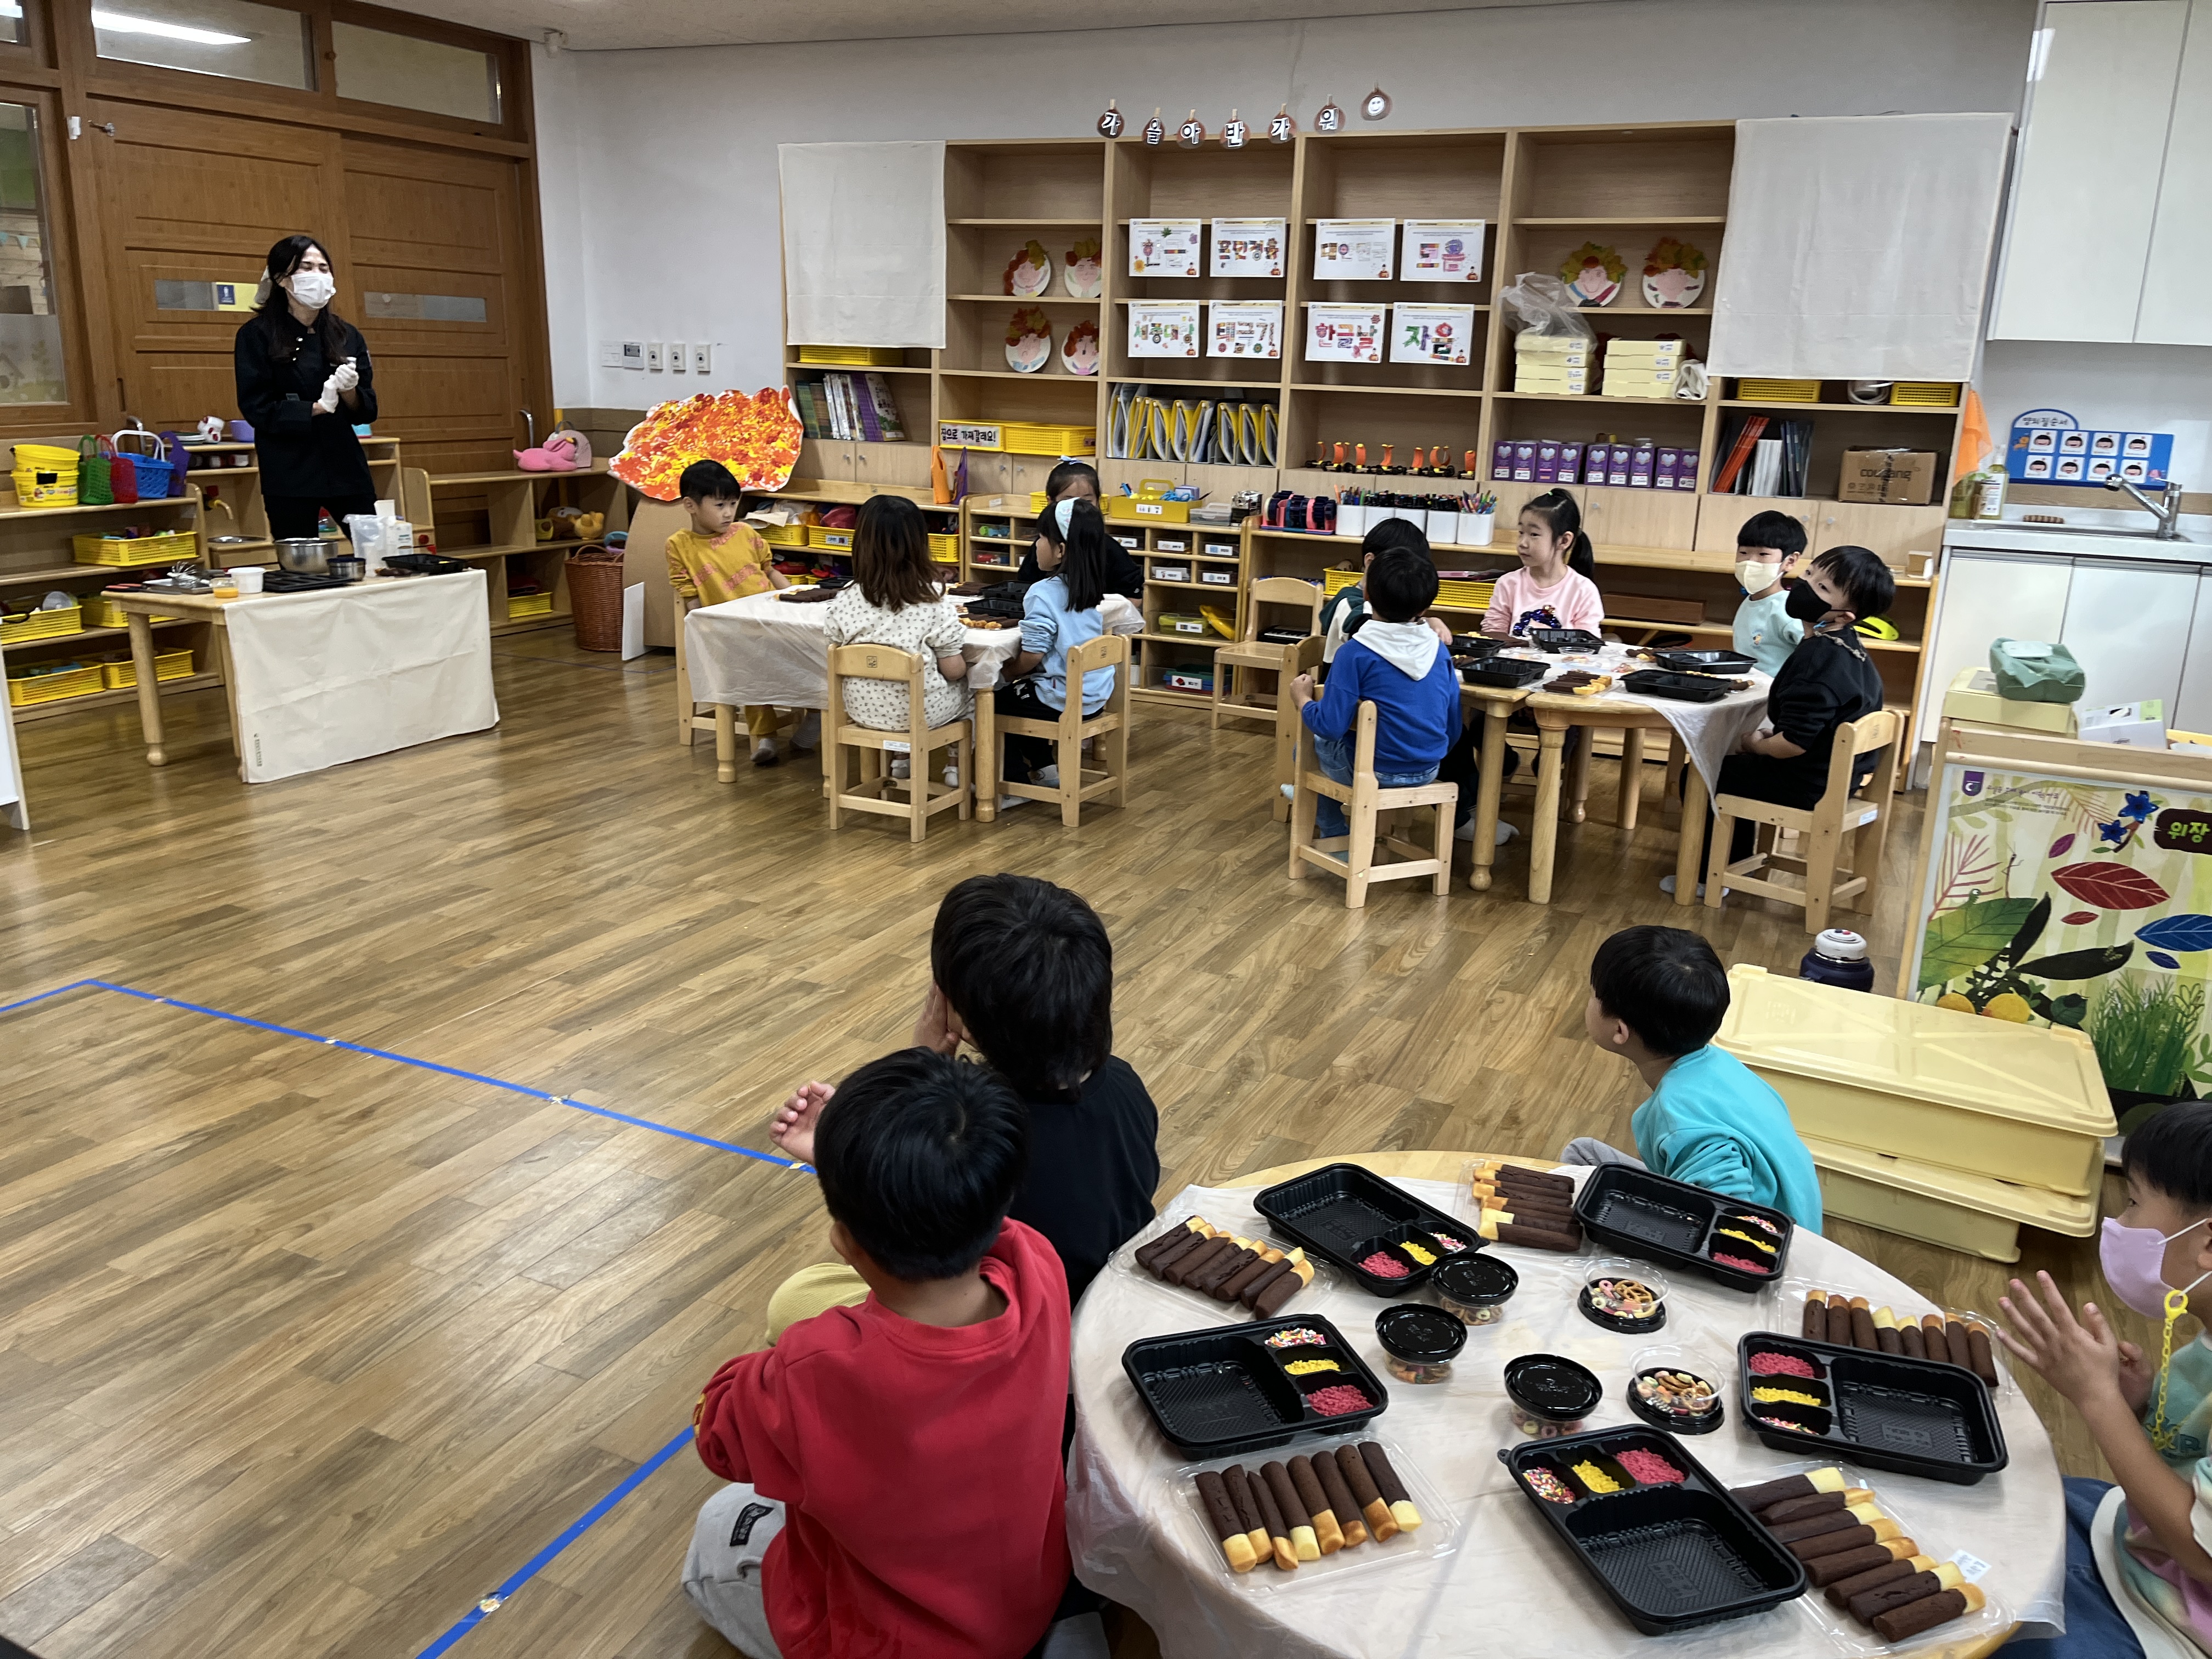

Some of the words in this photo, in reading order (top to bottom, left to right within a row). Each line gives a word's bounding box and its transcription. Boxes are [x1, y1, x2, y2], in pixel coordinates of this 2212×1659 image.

[1316, 323, 1377, 349] 한글날
[1403, 323, 1455, 362] 자음
[941, 428, 958, 441] 집으로
[2168, 822, 2211, 843] 위장
